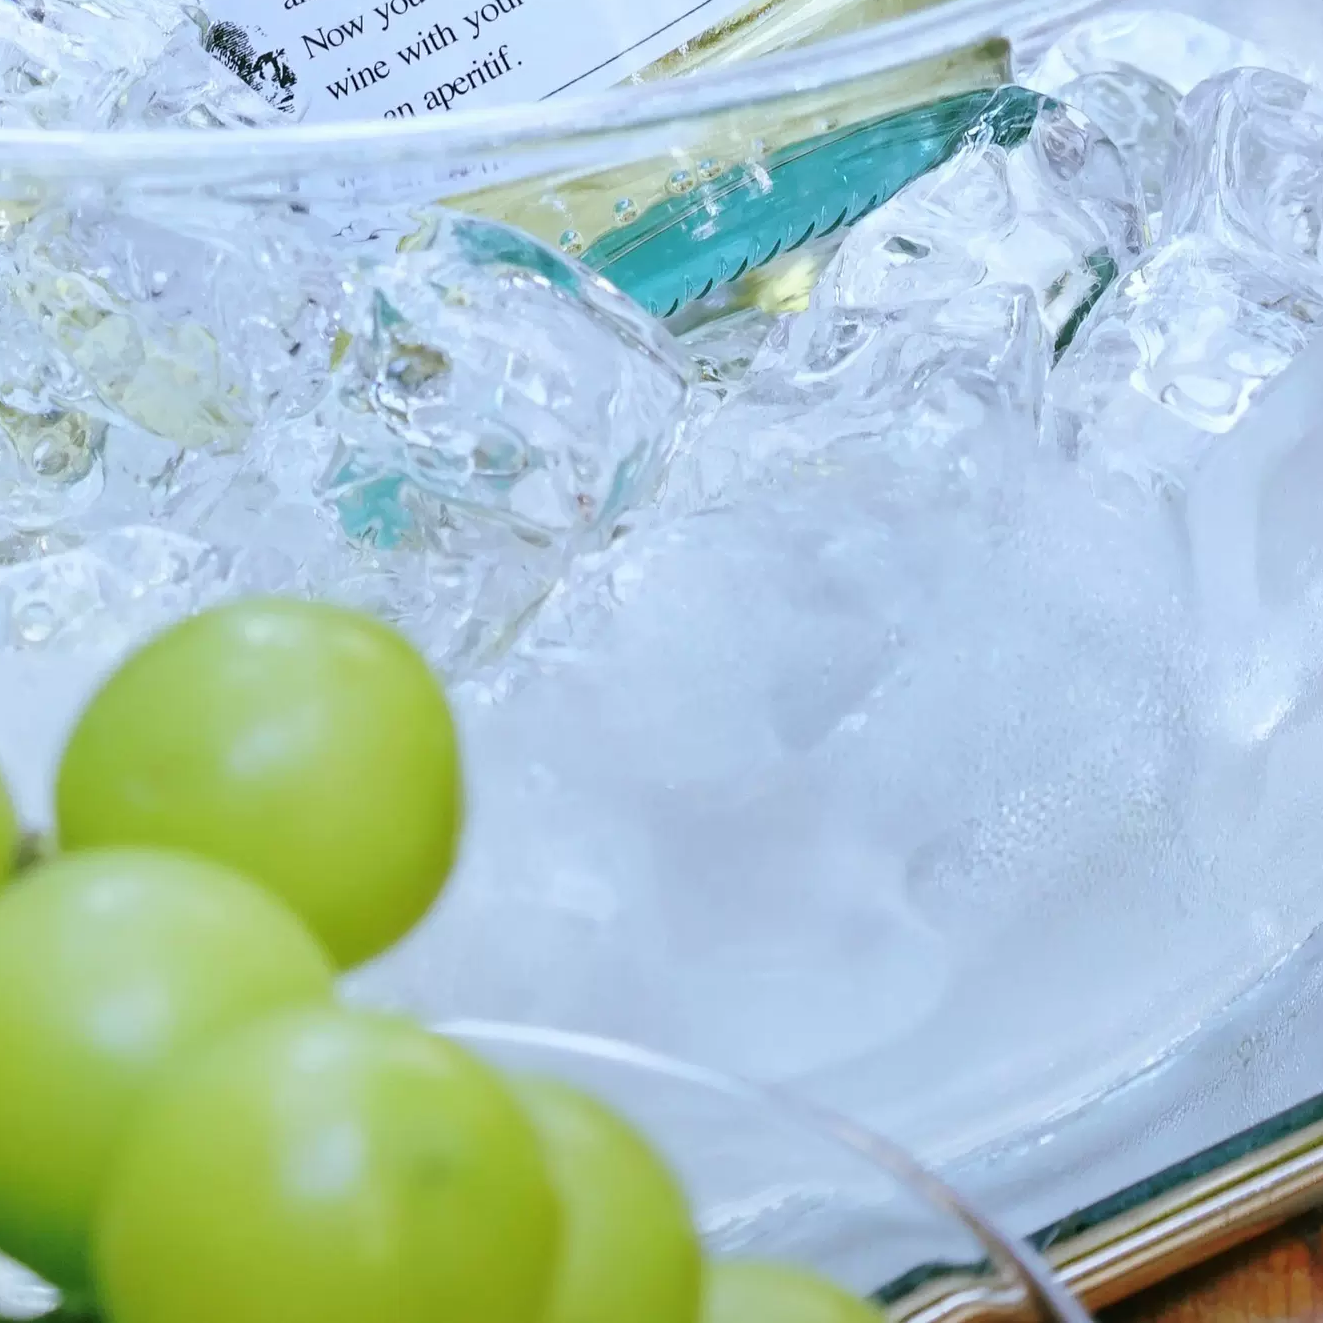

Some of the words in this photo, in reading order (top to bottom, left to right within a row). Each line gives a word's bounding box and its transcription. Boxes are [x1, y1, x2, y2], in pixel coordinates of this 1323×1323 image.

[300, 15, 366, 60] Now
[325, 59, 391, 101] wine
[395, 22, 458, 66] with
[422, 45, 524, 112] aperitif.
